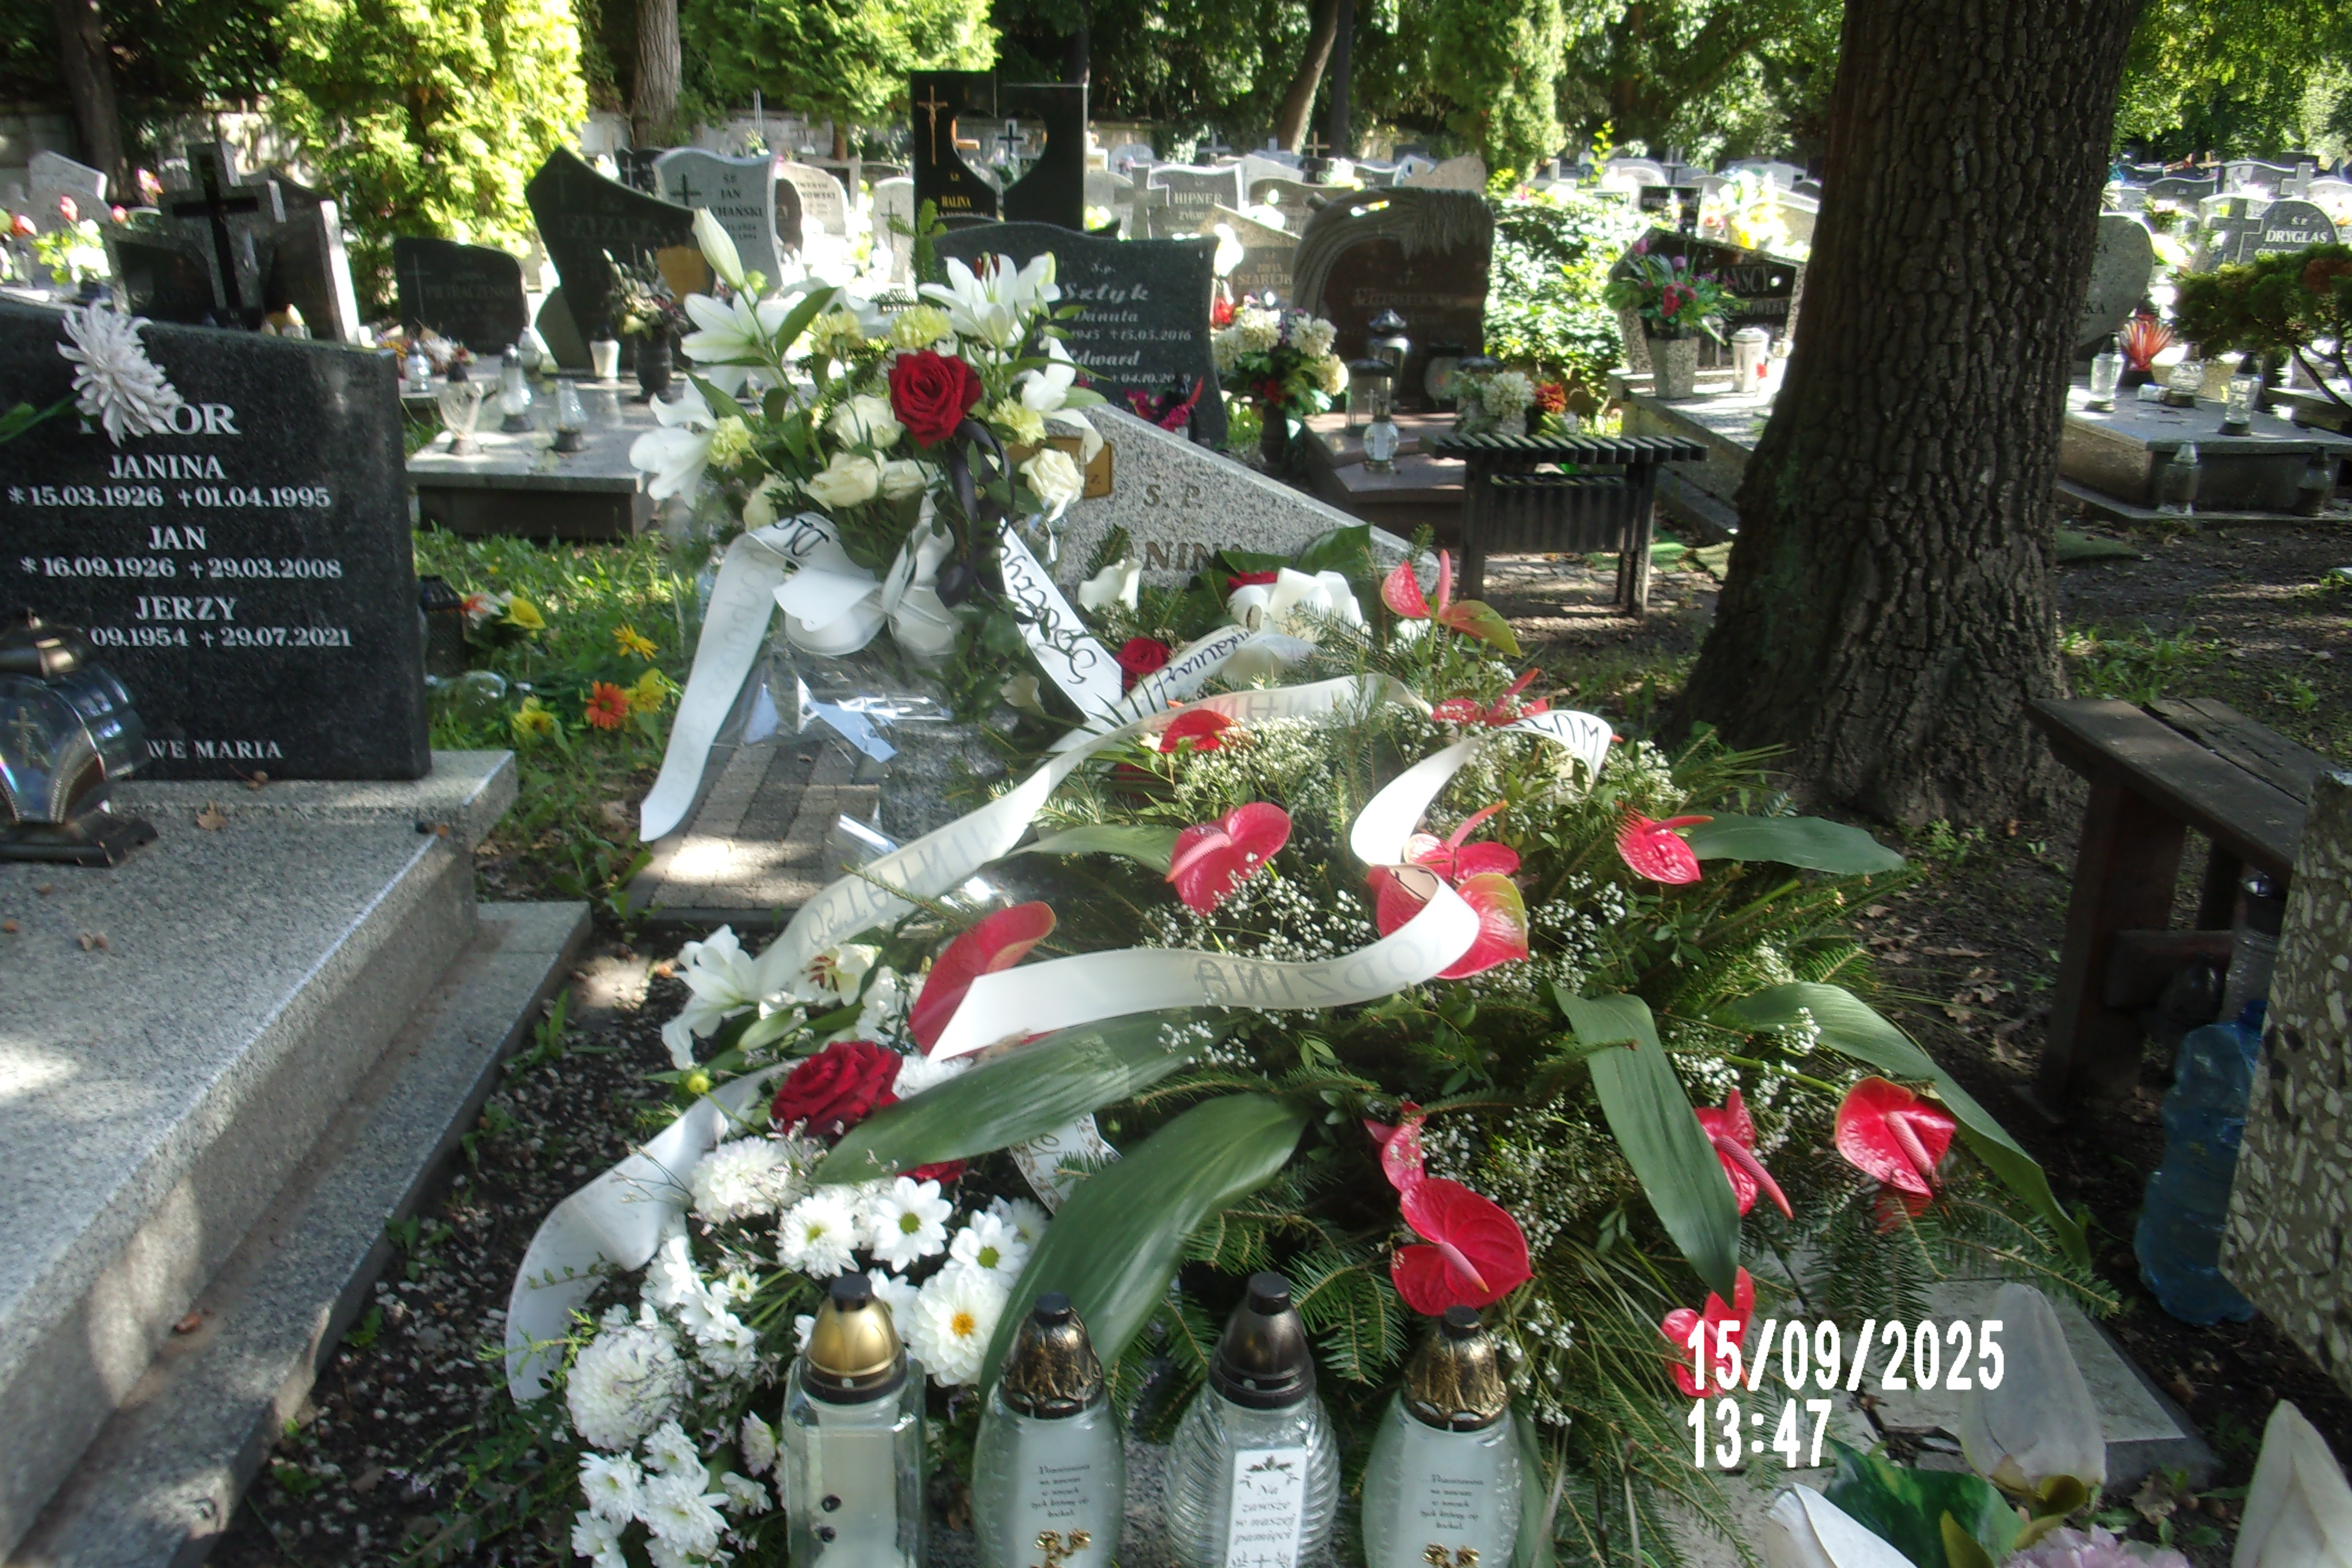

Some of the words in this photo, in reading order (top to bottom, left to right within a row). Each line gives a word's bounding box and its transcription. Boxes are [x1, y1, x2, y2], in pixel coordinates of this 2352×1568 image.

[1174, 191, 1223, 204] HIPNER
[2264, 230, 2329, 244] DRYGLAS
[109, 454, 228, 480] JANINA
[148, 525, 207, 550] JAN
[135, 596, 238, 621] JERZY
[194, 740, 284, 760] MARIA
